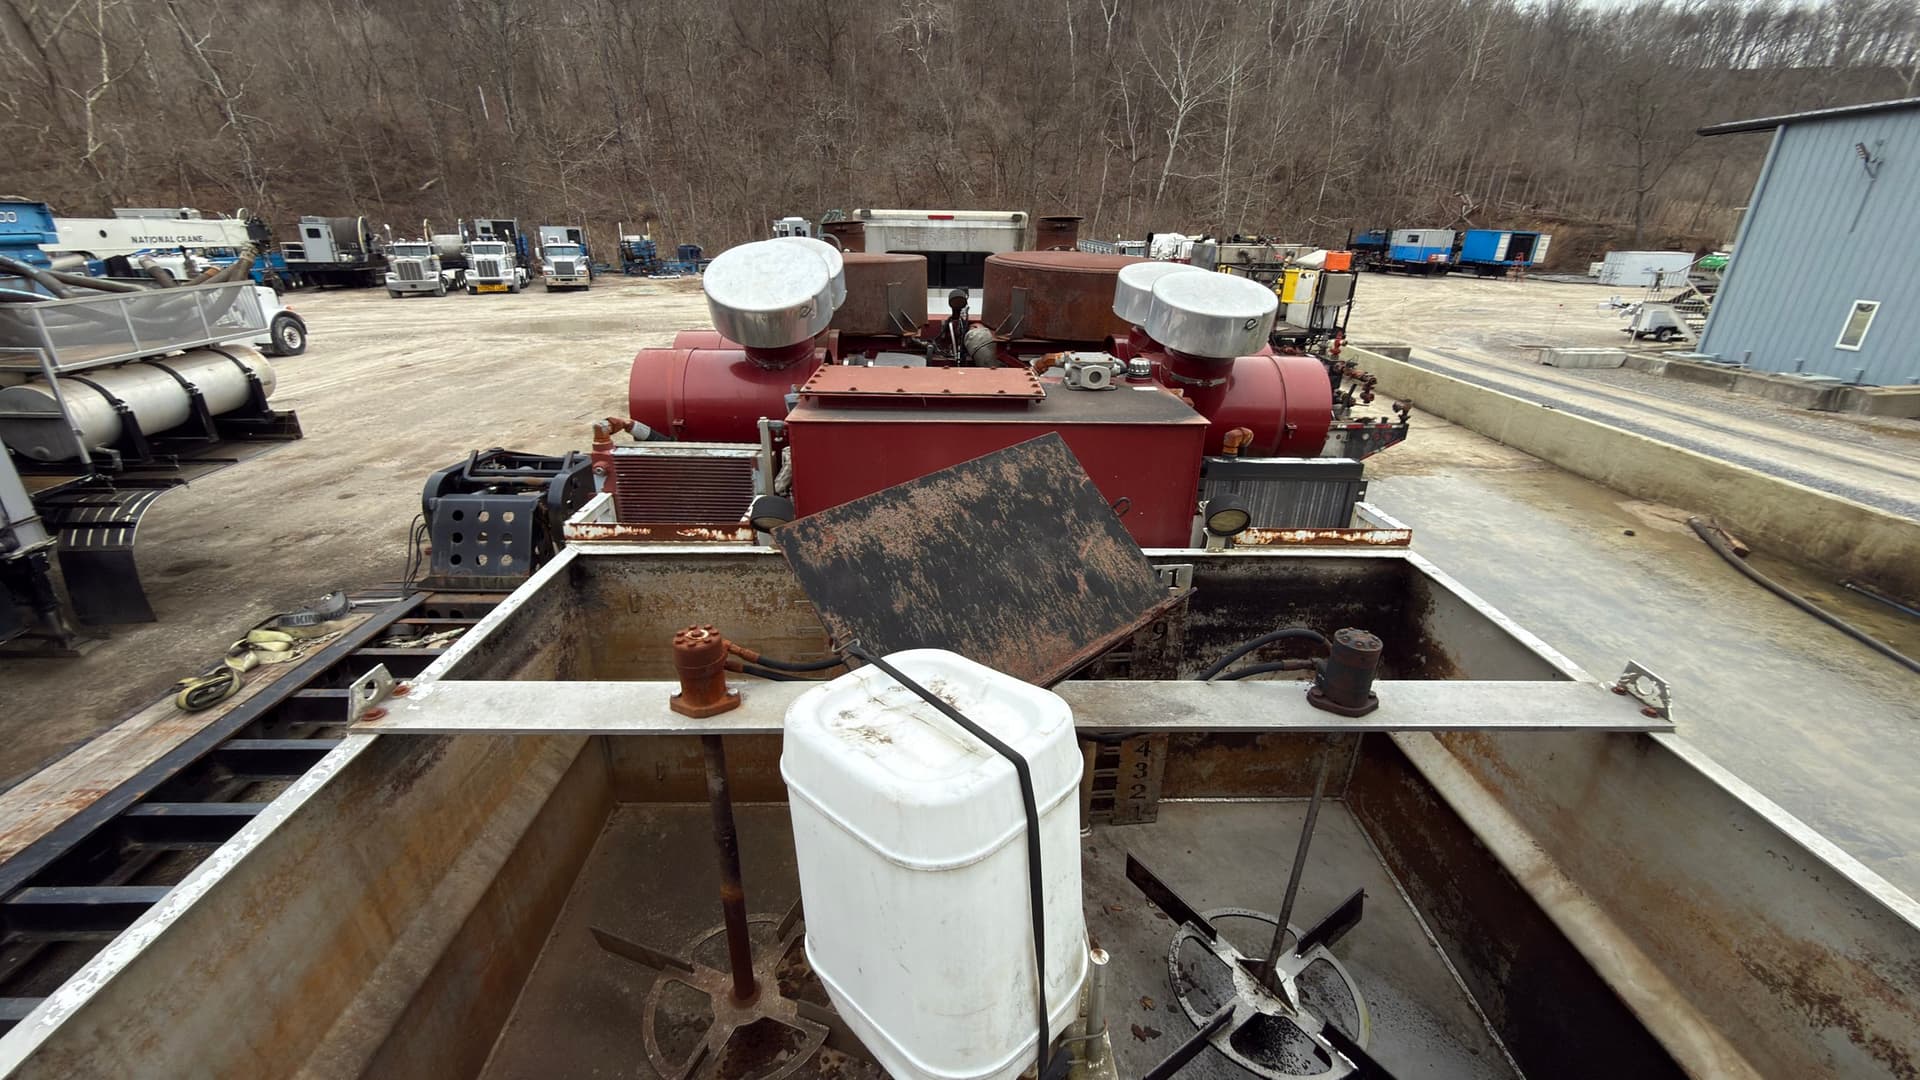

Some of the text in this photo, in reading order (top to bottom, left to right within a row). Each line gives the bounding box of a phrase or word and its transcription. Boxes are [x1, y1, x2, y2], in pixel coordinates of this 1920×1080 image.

[130, 235, 176, 244] NATIONAL
[176, 235, 204, 243] CRANE
[1152, 622, 1168, 641] 9
[1135, 740, 1152, 757] 4
[1133, 762, 1148, 779] 3
[1129, 783, 1146, 800] 2
[1132, 805, 1143, 821] 1
